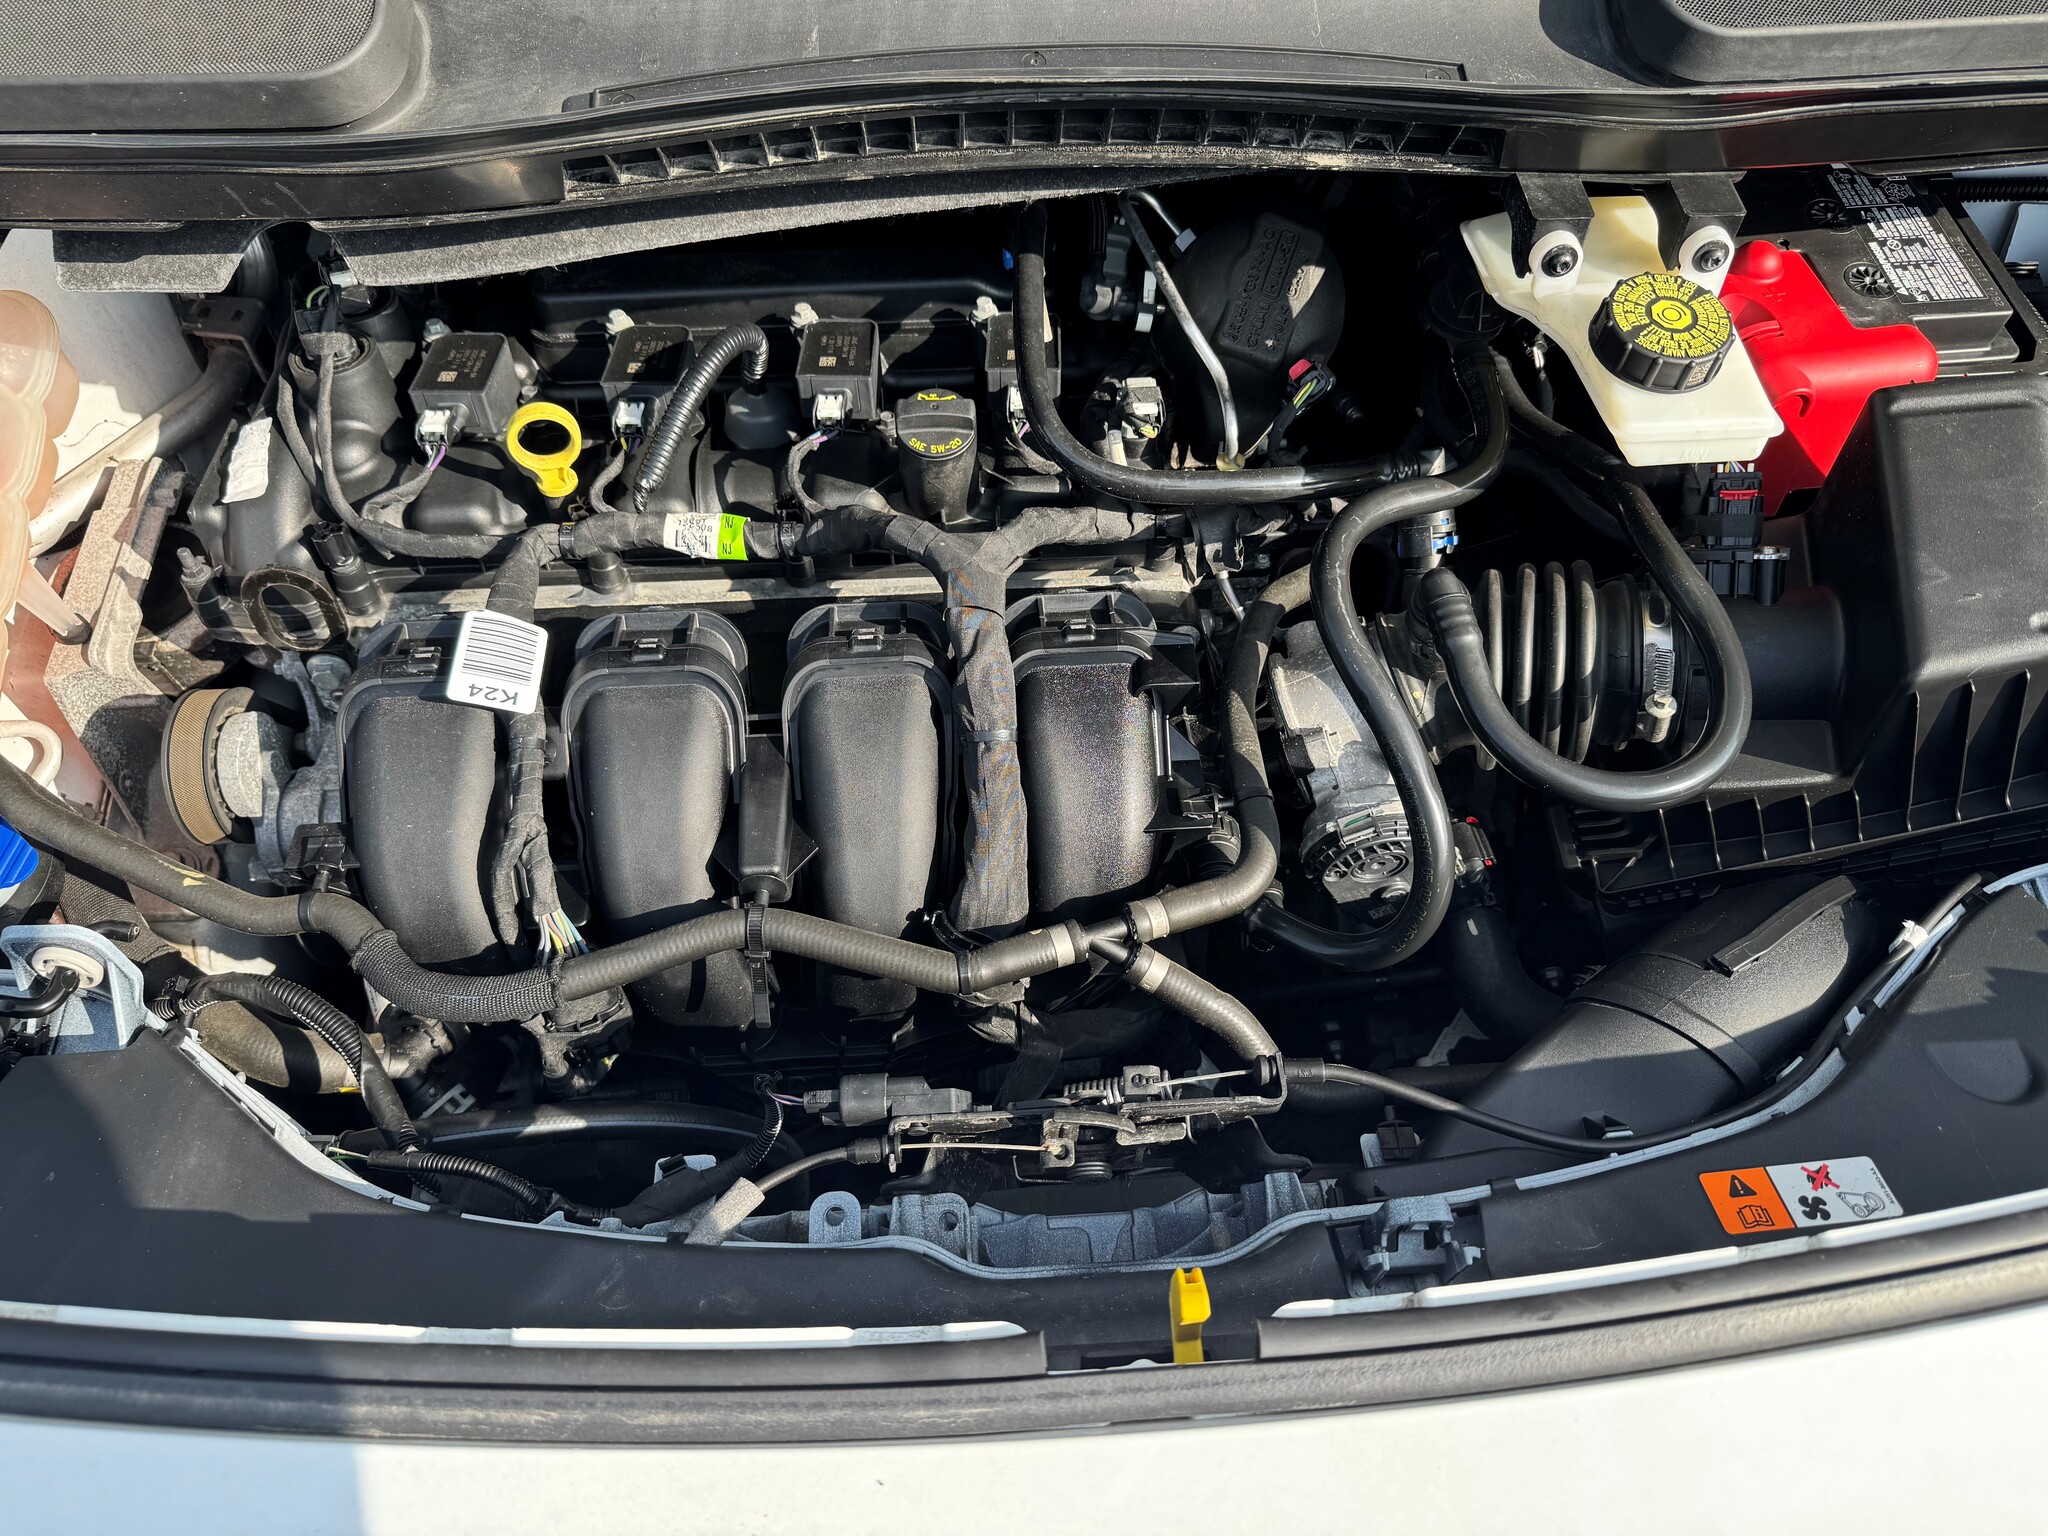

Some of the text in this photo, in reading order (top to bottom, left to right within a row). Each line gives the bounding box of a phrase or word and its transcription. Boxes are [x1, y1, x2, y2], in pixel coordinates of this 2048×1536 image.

[1633, 275, 1653, 284] FROM
[1653, 274, 1673, 282] FLUID
[1650, 281, 1677, 290] BEFORE
[1682, 279, 1698, 290] DOT
[1679, 285, 1694, 296] CAP
[1644, 332, 1659, 343] DOT
[1662, 347, 1686, 357] AVANT
[909, 437, 963, 453] SAE 5W-20
[724, 516, 735, 528] NJ
[722, 543, 732, 555] NJ
[468, 683, 519, 705] K24
